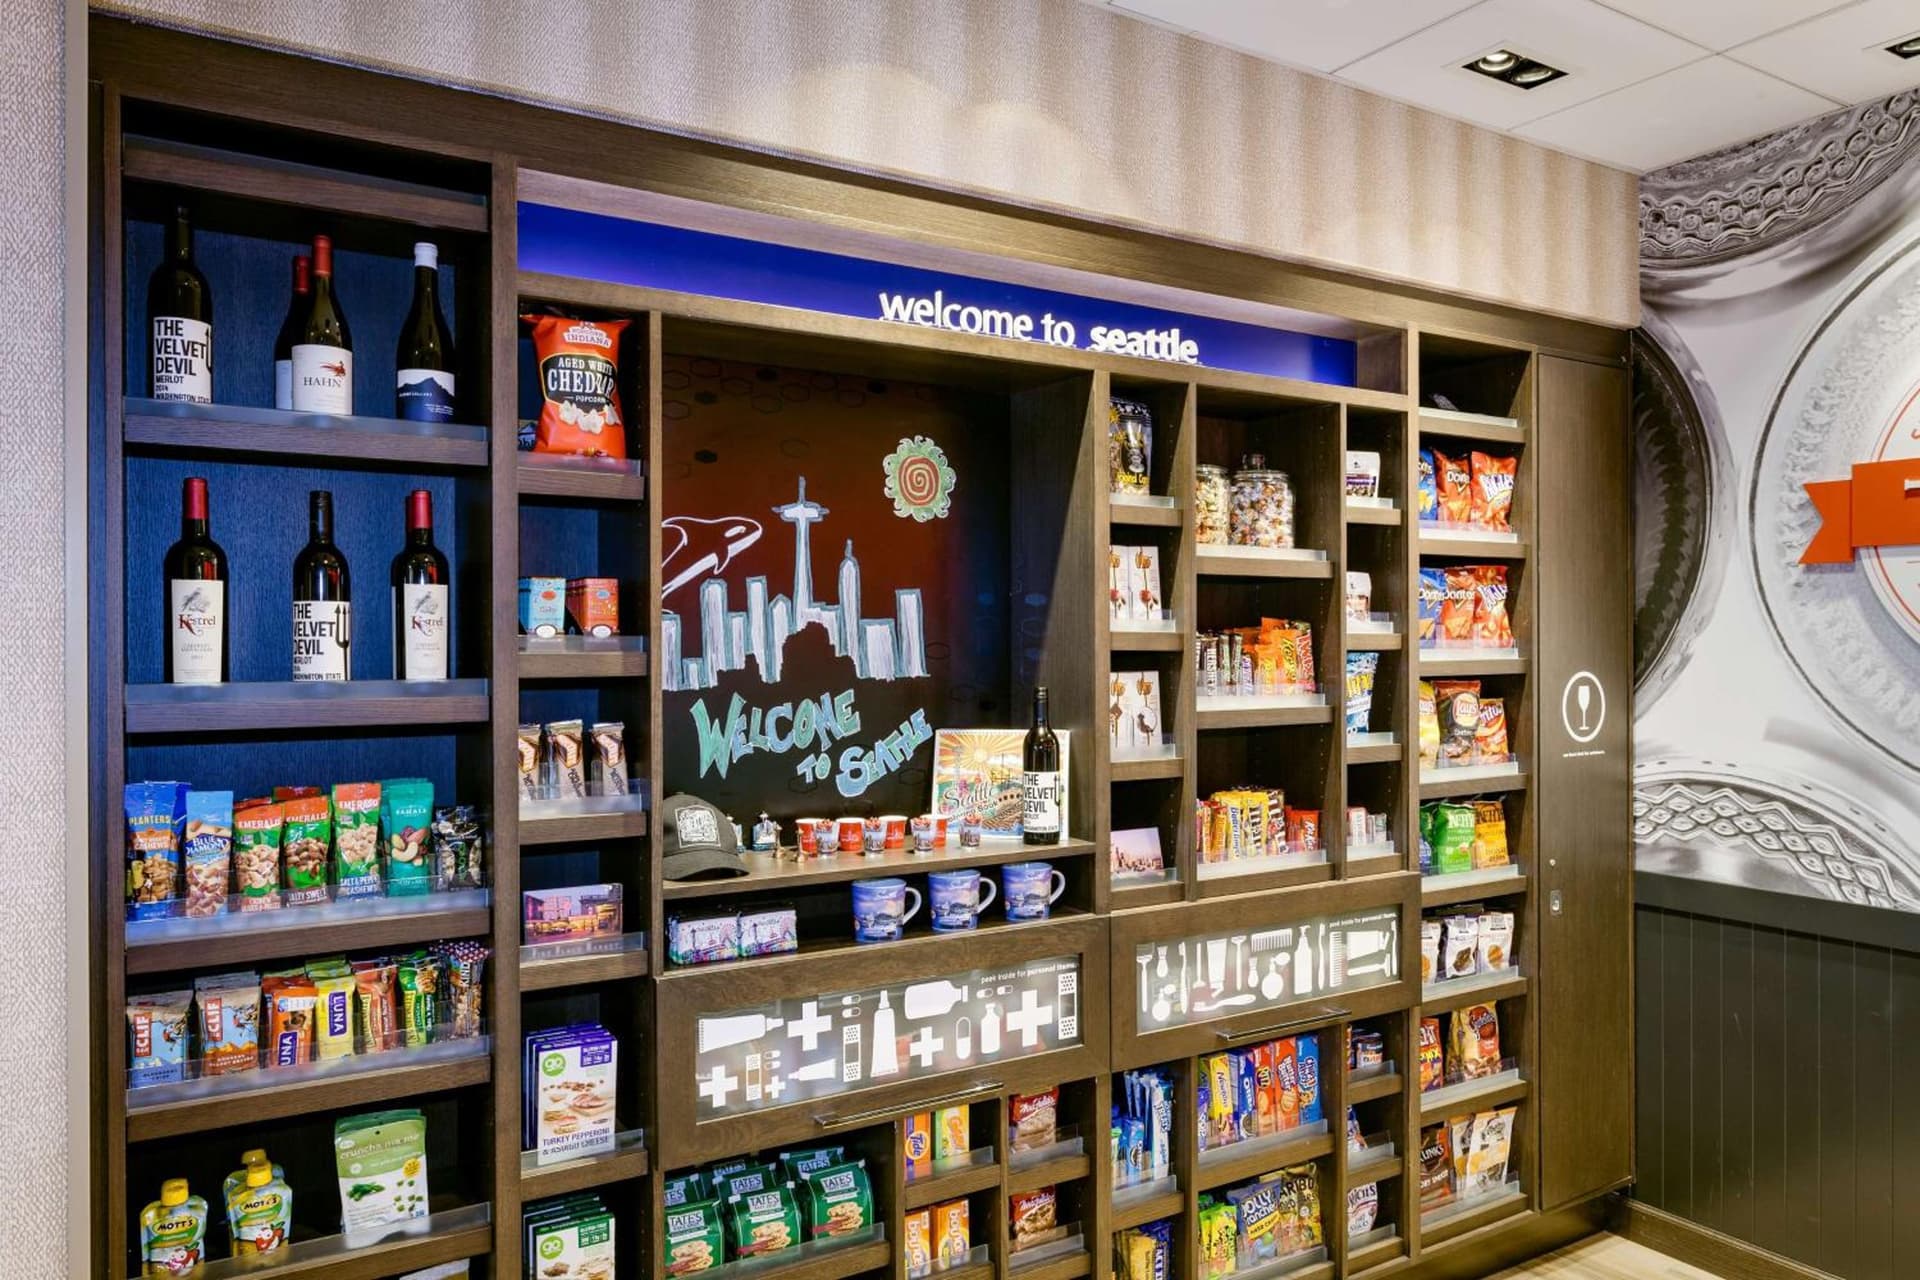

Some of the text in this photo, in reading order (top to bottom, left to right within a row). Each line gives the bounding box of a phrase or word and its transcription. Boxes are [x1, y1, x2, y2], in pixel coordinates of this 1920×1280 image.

[156, 320, 184, 336] THE
[879, 290, 1199, 364] welcome to seattle
[567, 333, 609, 346] INDIANA
[156, 338, 206, 360] VELVET
[156, 358, 197, 376] DEVIL
[558, 357, 585, 369] AGED
[303, 376, 342, 388] HAHN
[1024, 774, 1038, 786] THE
[239, 816, 282, 829] EMERALD
[334, 995, 344, 1032] LUNA
[281, 1036, 293, 1066] UNA
[543, 1134, 570, 1147] TURKEY
[911, 1134, 924, 1157] Tide
[824, 1174, 852, 1188] TATE'S
[750, 1195, 780, 1206] TATE'S
[1242, 1190, 1272, 1216] JOLLY
[158, 1219, 193, 1231] MOTT'S
[670, 1214, 702, 1227] TATE'S
[950, 1209, 963, 1256] bounce
[908, 1221, 923, 1269] bounce
